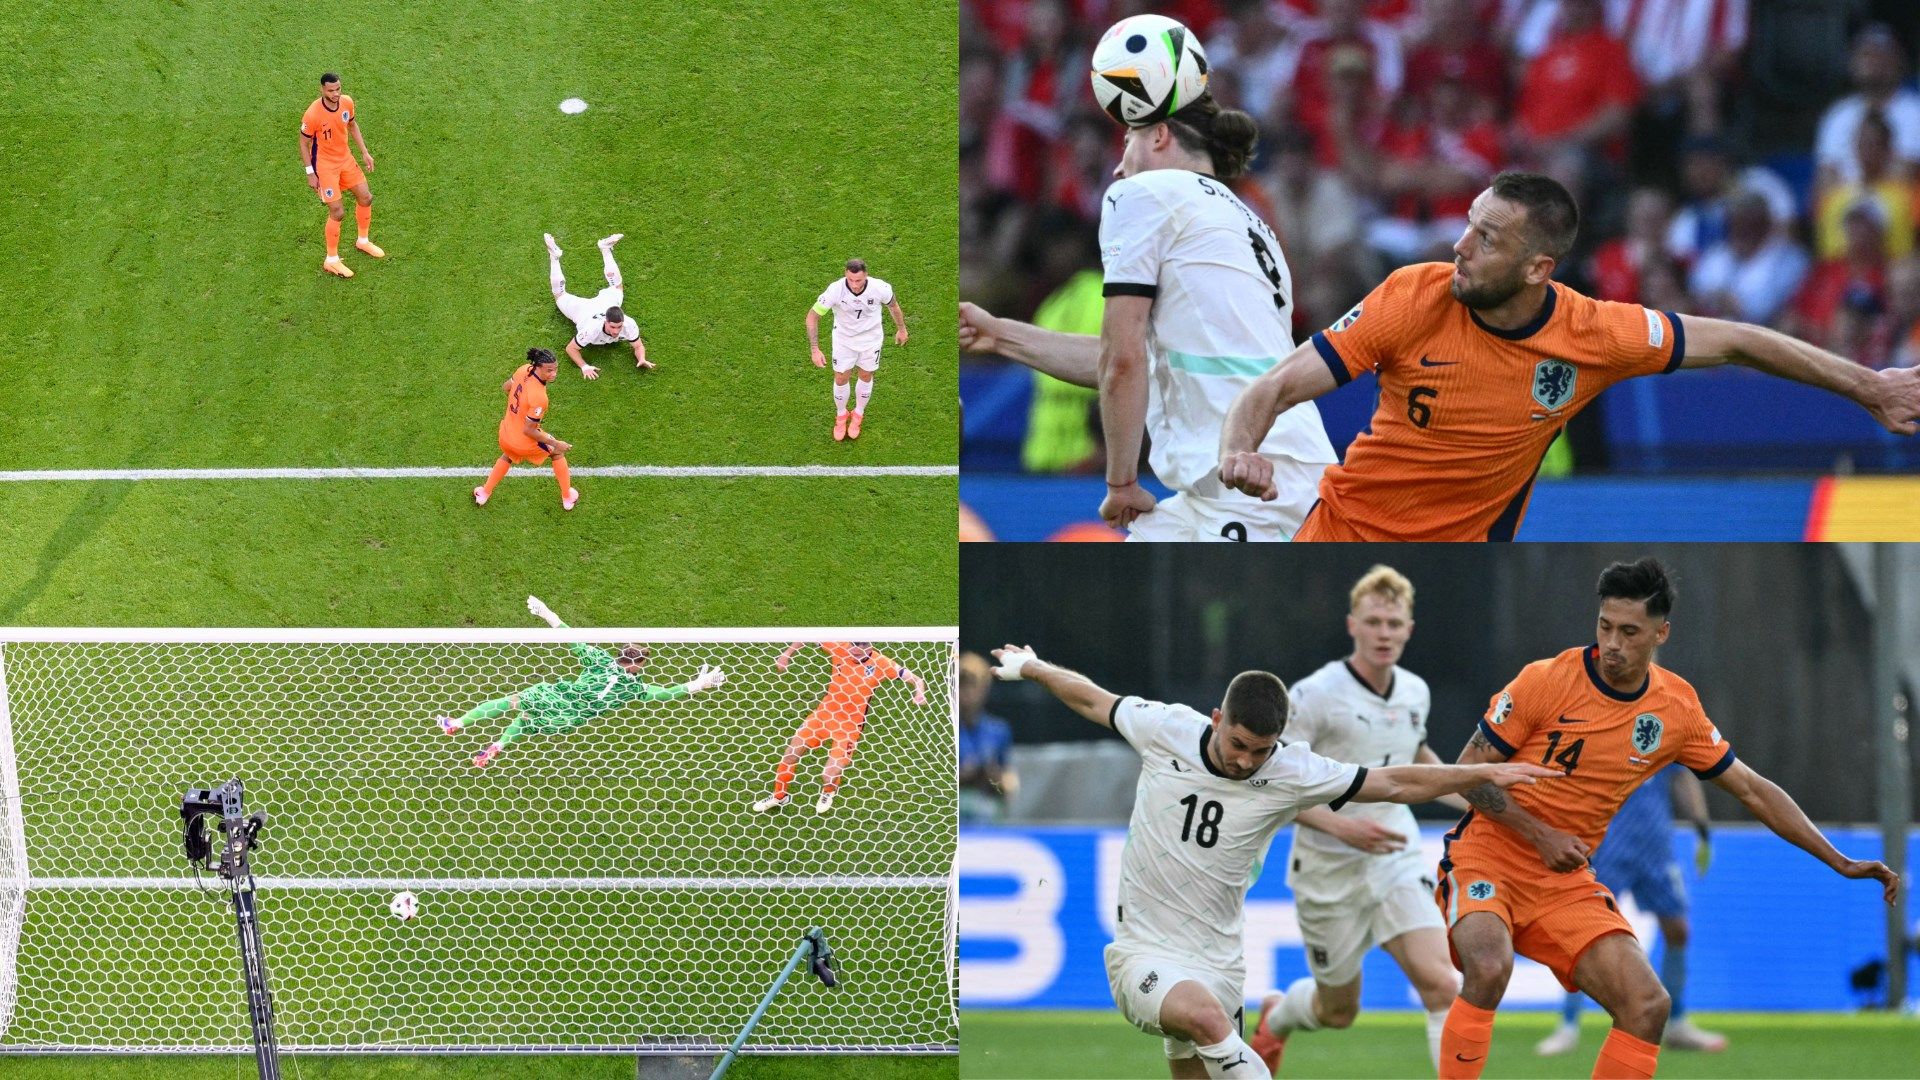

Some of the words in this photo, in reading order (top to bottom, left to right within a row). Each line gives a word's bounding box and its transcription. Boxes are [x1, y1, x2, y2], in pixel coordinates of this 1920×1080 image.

[854, 309, 863, 319] 7
[509, 383, 523, 415] 5
[1407, 386, 1438, 429] 6
[1541, 730, 1585, 777] 14
[1180, 793, 1224, 849] 18
